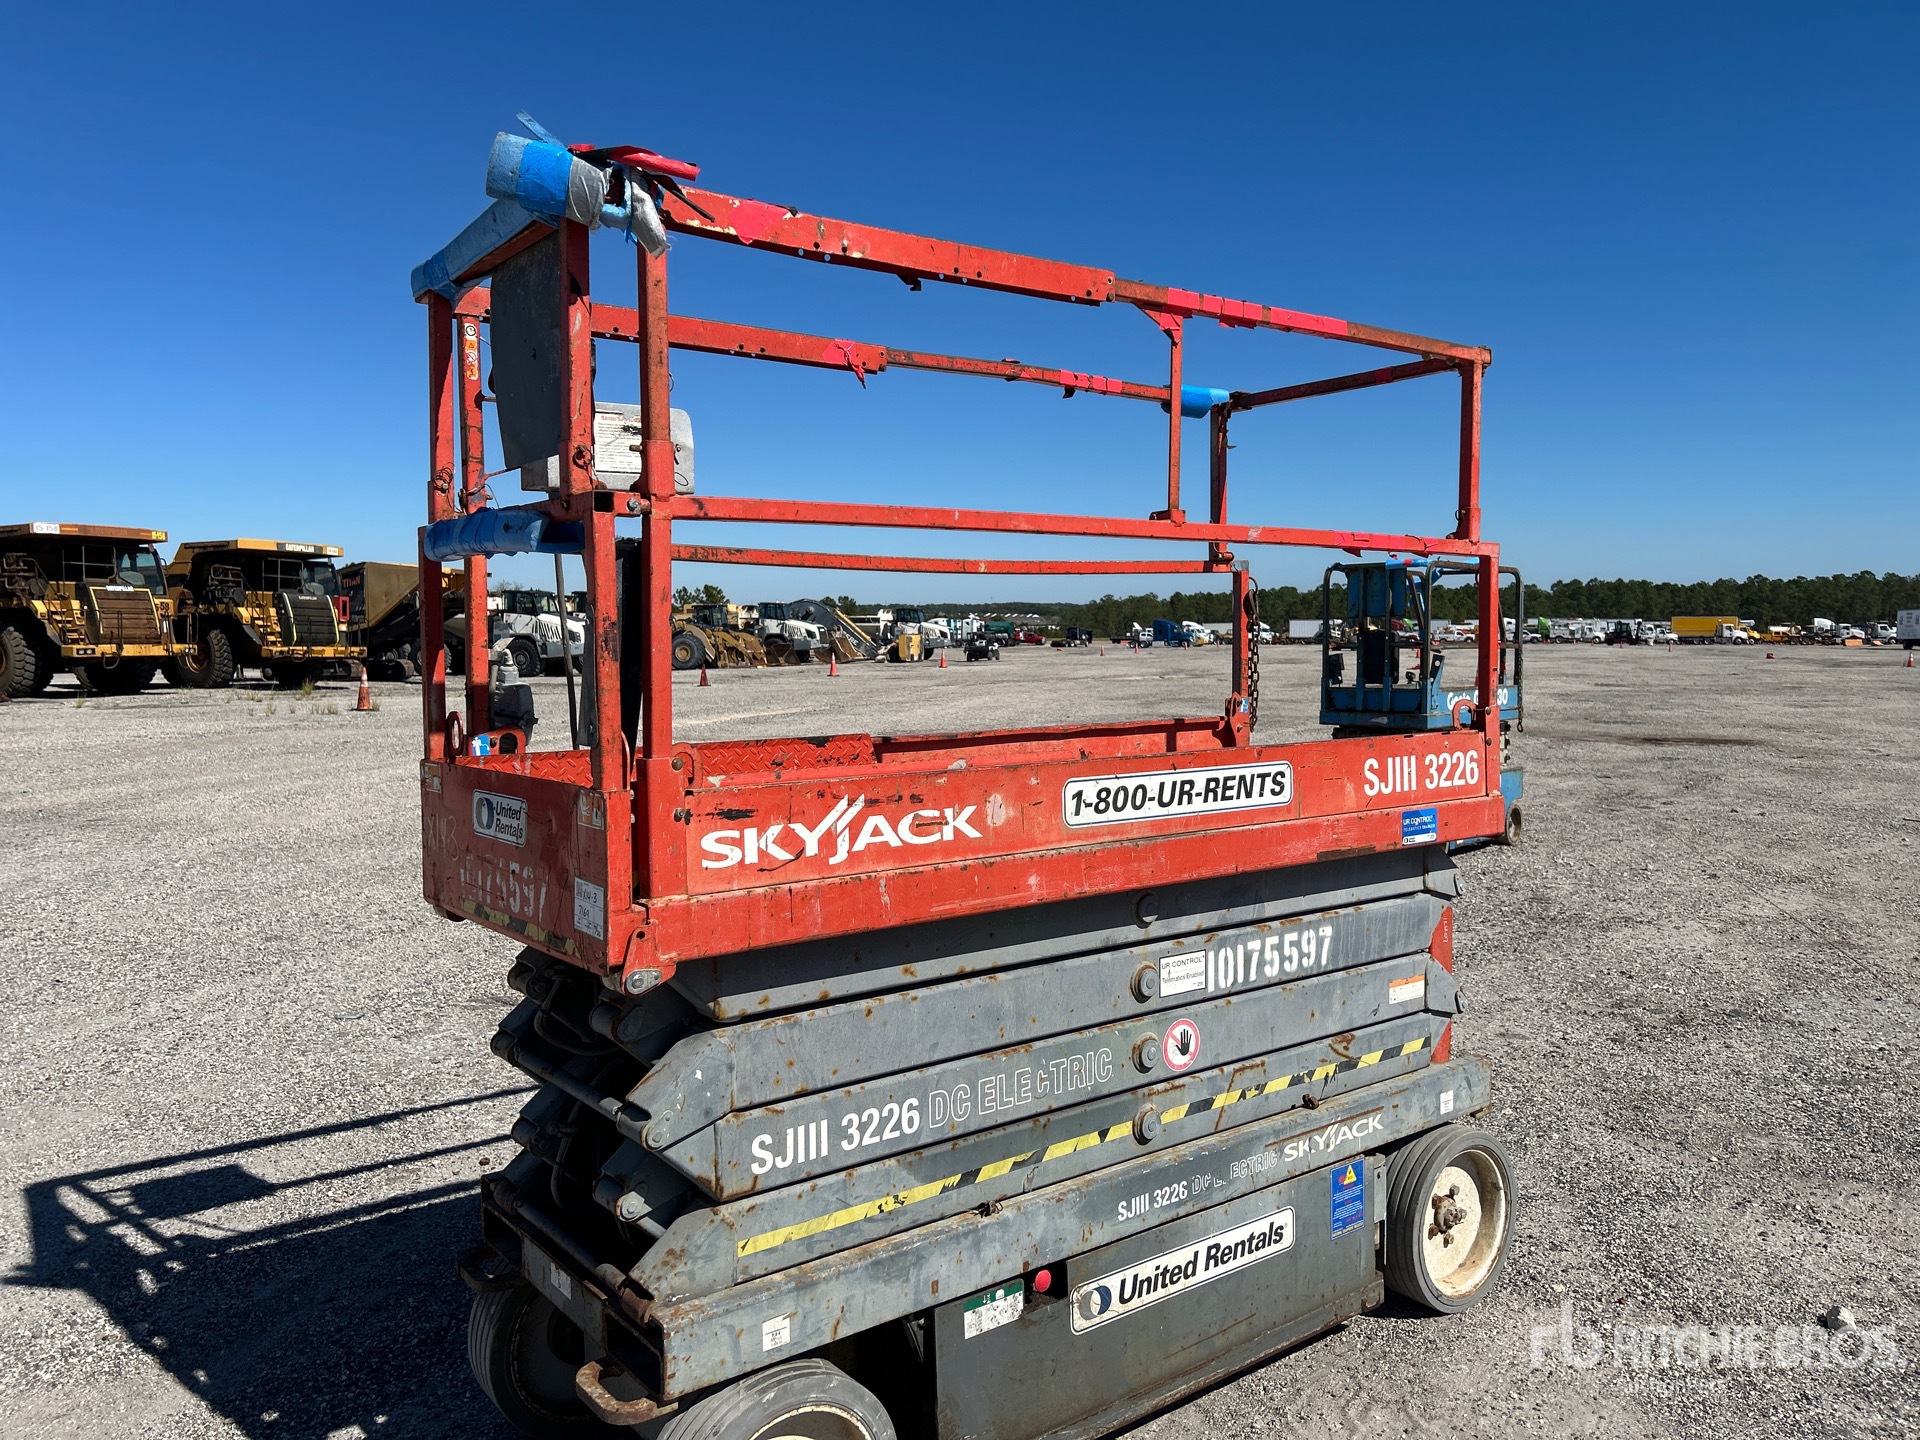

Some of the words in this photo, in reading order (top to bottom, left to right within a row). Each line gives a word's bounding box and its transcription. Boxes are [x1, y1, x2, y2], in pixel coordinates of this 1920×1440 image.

[285, 543, 316, 554] CATERPILLAR
[1424, 749, 1479, 790] 3226
[495, 800, 522, 821] United
[1071, 770, 1286, 817] 1-800-UR-RENTS
[494, 818, 524, 841] Rentals
[700, 793, 983, 869] SKYJACK
[1161, 962, 1170, 970] UR
[1186, 970, 1204, 979] Enabled
[1207, 926, 1333, 993] 10175597
[750, 1118, 829, 1175] SJIII
[840, 1097, 921, 1151] 3226
[929, 1083, 971, 1129] DC
[978, 1047, 1113, 1116] ELECTRIC
[1283, 1115, 1384, 1162] SKYJACK
[1117, 1189, 1149, 1222] SJIII
[1153, 1180, 1188, 1209] 3226
[1118, 1250, 1199, 1305] United
[1204, 1221, 1285, 1272] Rentals
